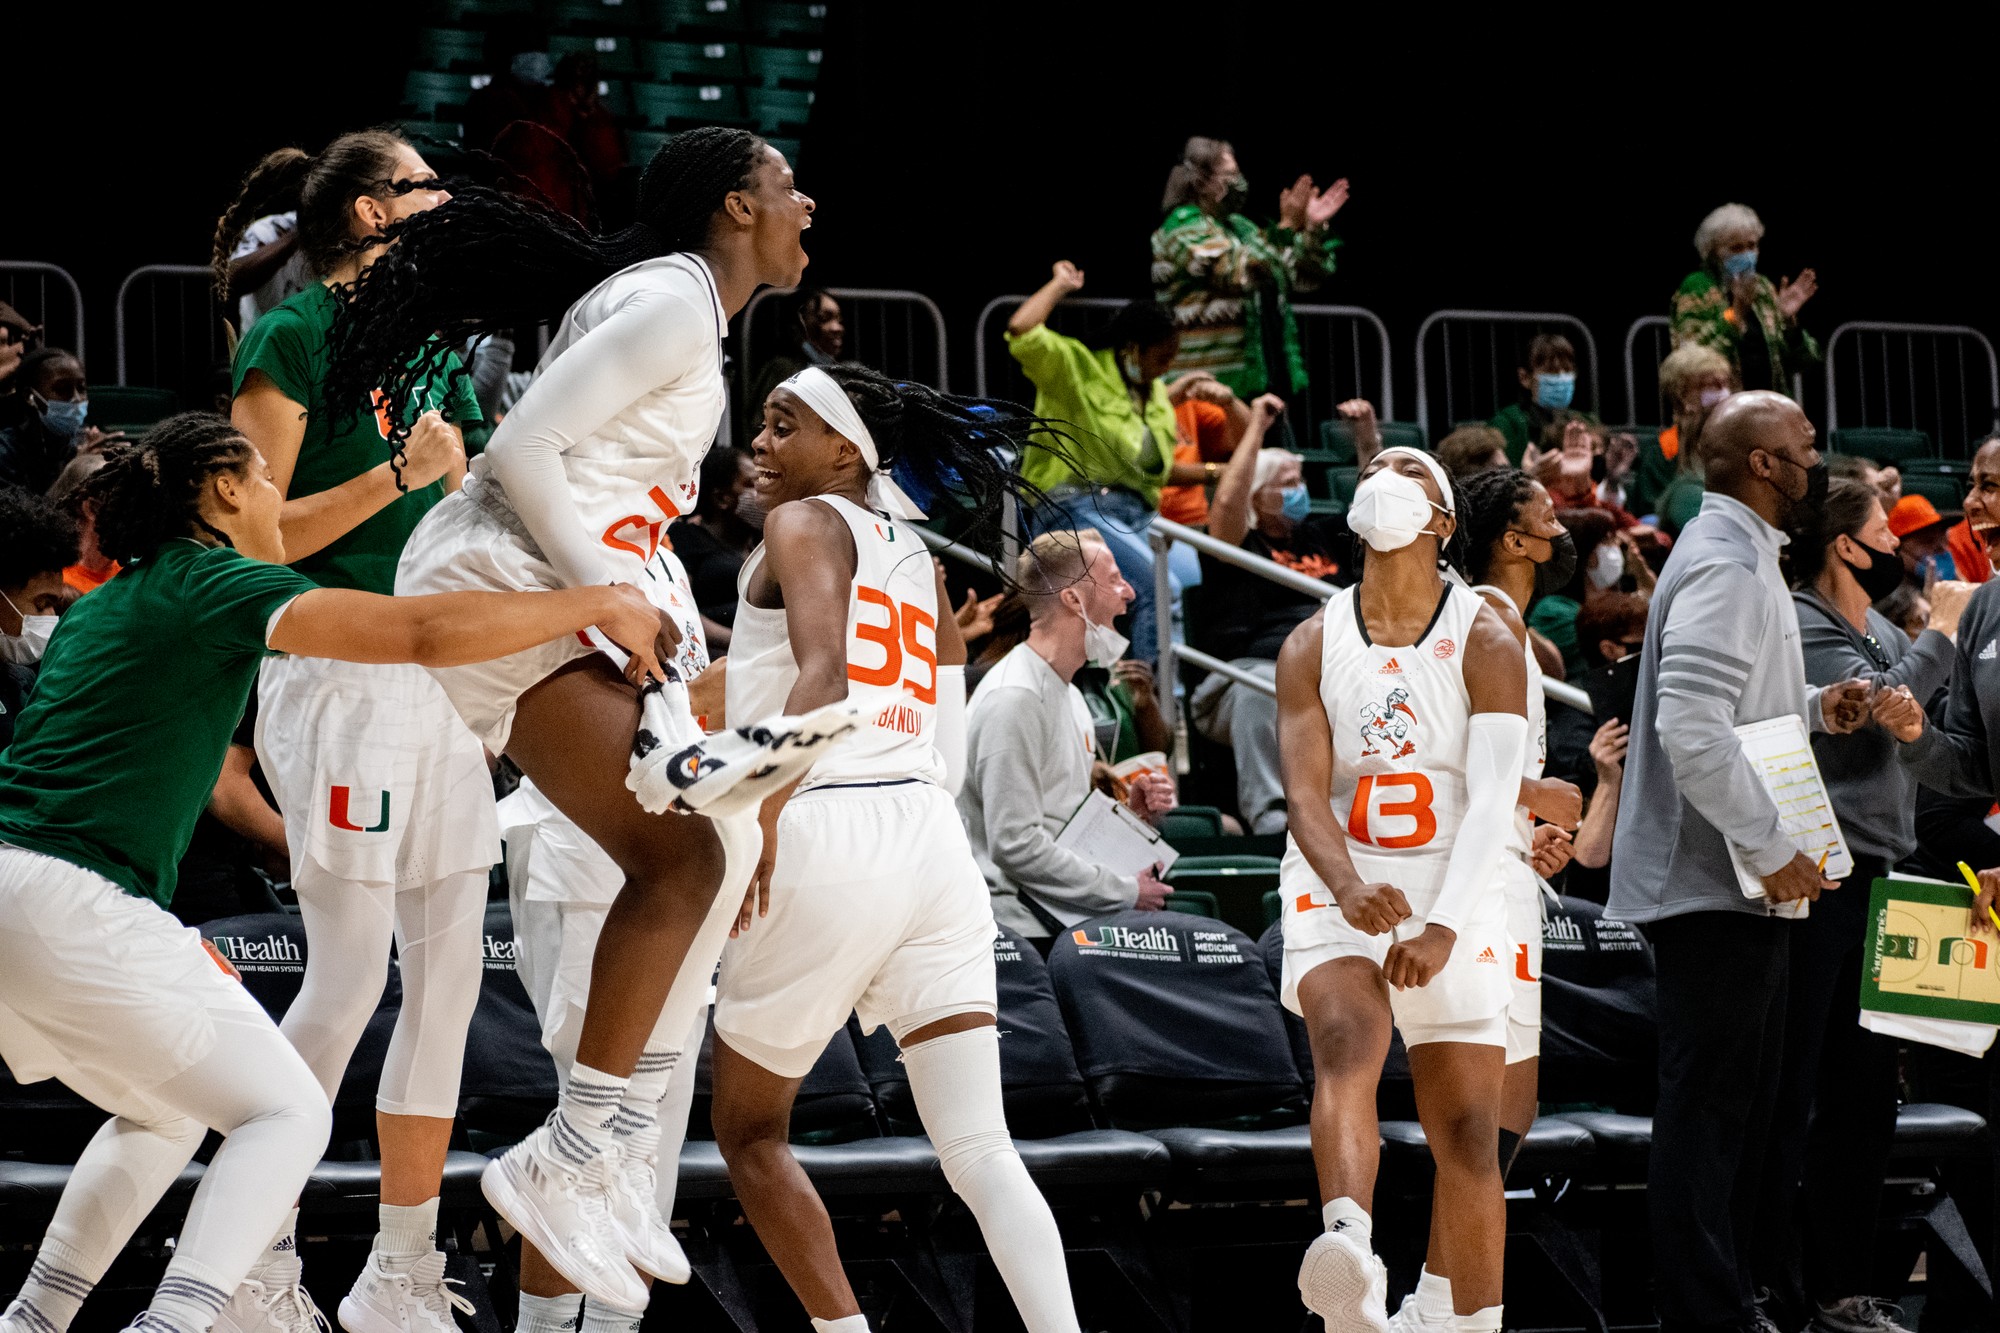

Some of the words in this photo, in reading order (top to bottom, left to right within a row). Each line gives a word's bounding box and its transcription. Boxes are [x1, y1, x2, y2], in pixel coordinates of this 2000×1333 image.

[874, 523, 895, 543] U
[847, 584, 937, 706] 35
[872, 704, 922, 737] BANDU
[329, 785, 391, 833] U
[1348, 772, 1437, 849] 13
[1594, 919, 1626, 929] SPORTS
[1193, 931, 1228, 942] SPORTS
[1596, 931, 1636, 940] MEDICINE
[1194, 942, 1238, 952] MEDICINE
[1599, 942, 1642, 951] INSTITUTE
[995, 952, 1022, 961] ITUTE
[1197, 954, 1244, 963] INSTITUTE
[236, 964, 257, 972] MIAMI
[257, 965, 280, 973] HEALTH
